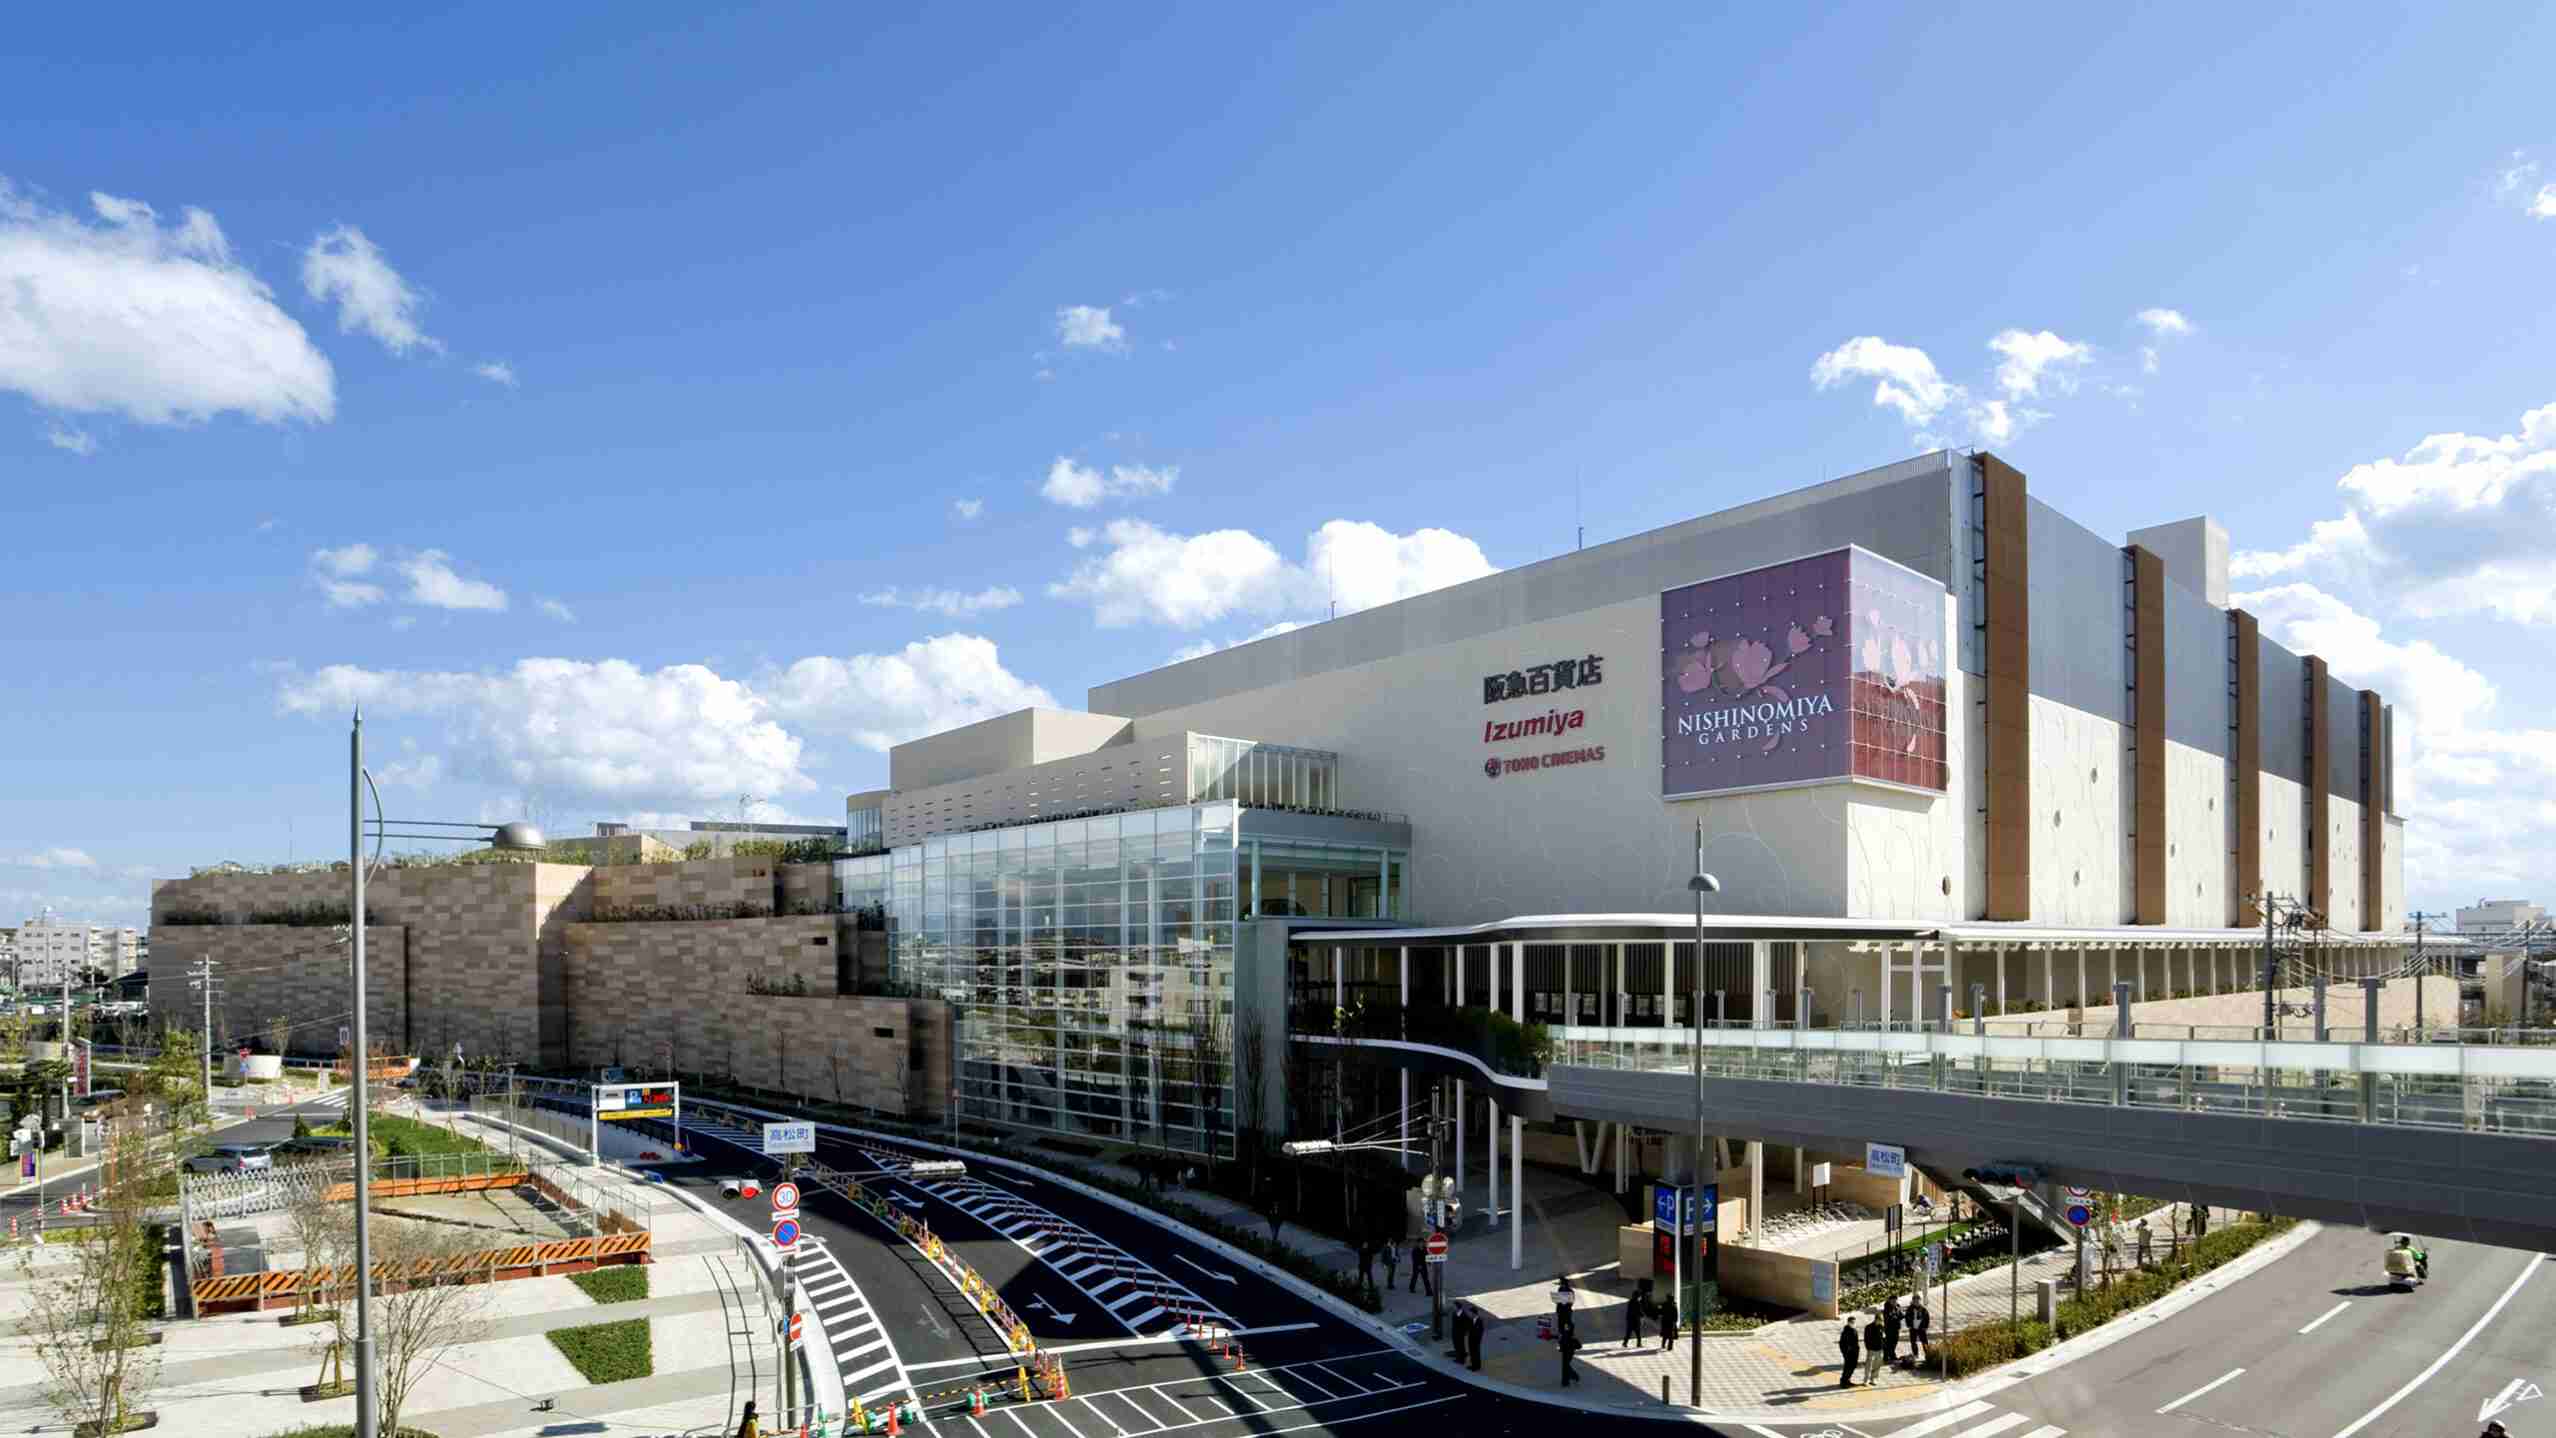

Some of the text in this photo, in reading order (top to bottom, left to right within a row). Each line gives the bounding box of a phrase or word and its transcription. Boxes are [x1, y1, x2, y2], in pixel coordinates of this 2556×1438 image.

[1484, 654, 1604, 705] 阪急百貨店
[1484, 708, 1584, 743] Izumiya
[1678, 694, 1833, 735] NISHINOMIYA
[1698, 718, 1809, 745] GARDENS
